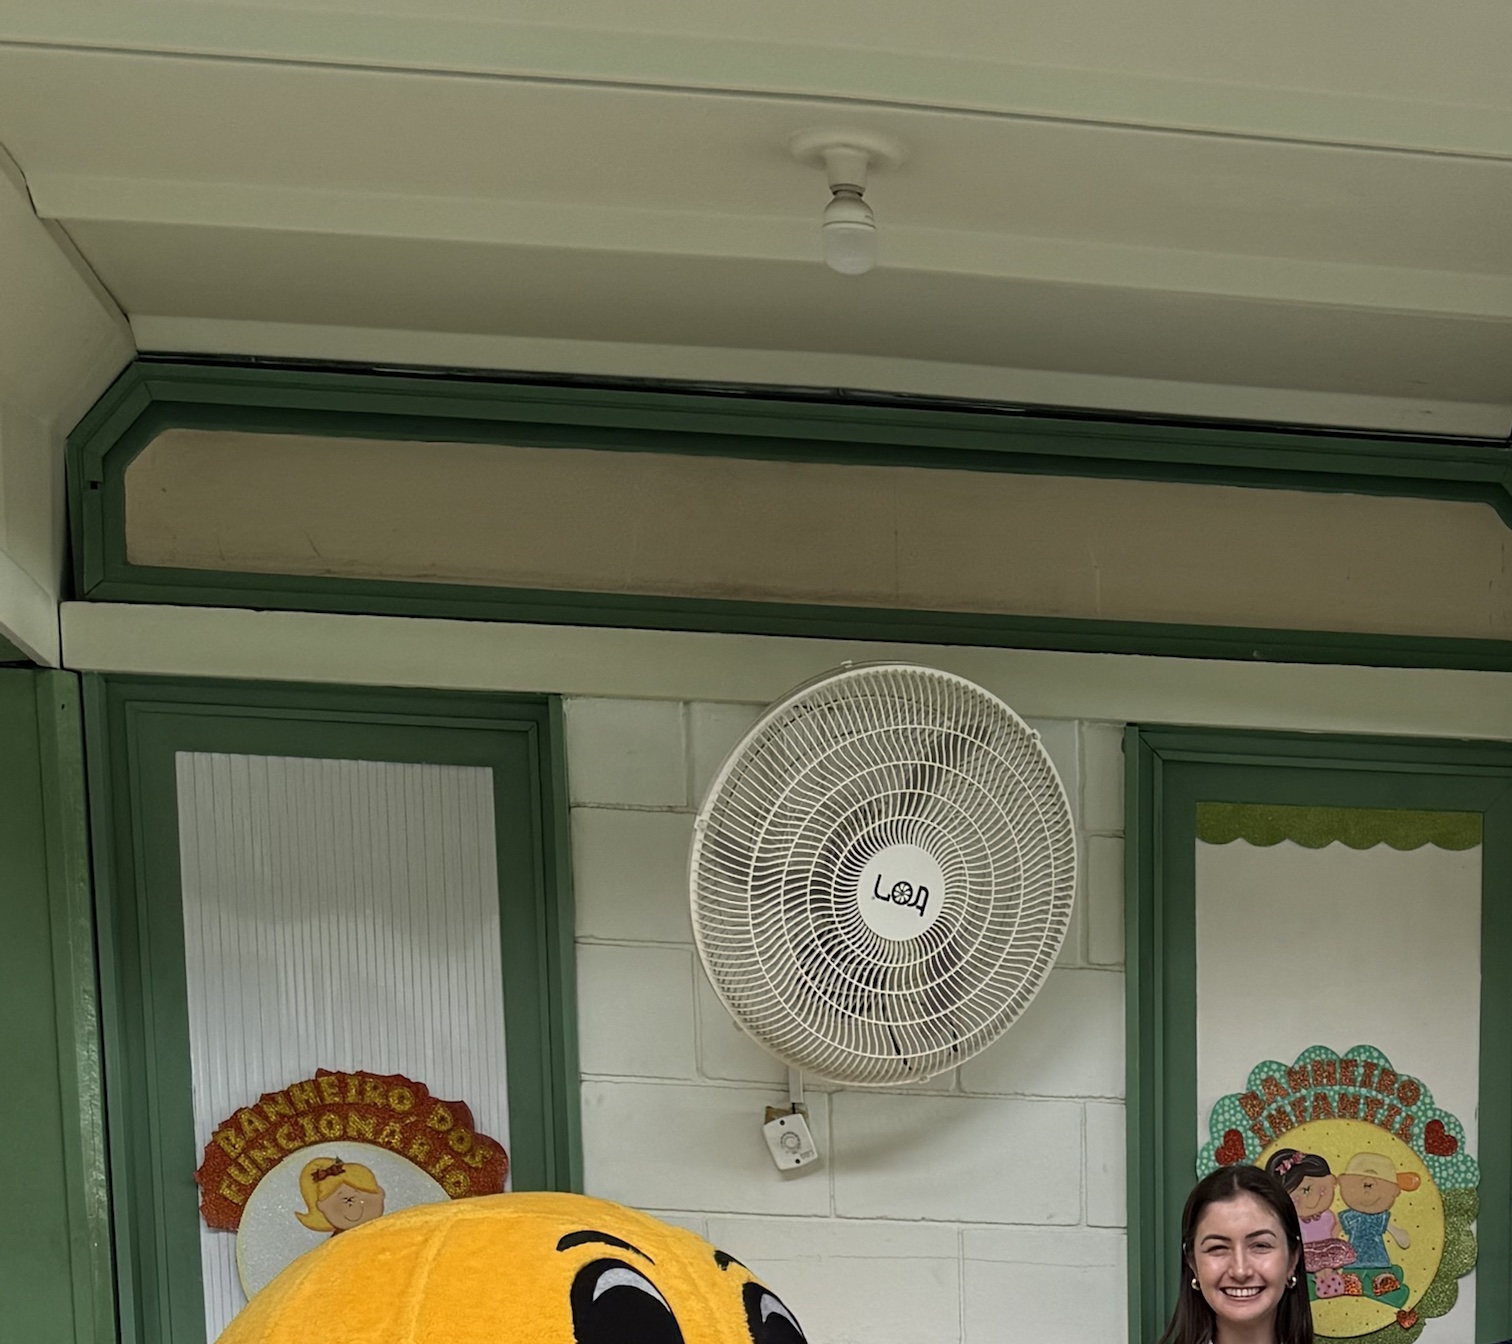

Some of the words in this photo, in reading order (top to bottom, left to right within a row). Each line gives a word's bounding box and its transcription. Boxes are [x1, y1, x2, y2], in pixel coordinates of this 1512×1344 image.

[212, 1073, 415, 1158] BANHEIRO
[427, 1102, 493, 1169] DOS
[1238, 1058, 1421, 1121] BANHEIRO
[1250, 1091, 1416, 1147] INFANTIL
